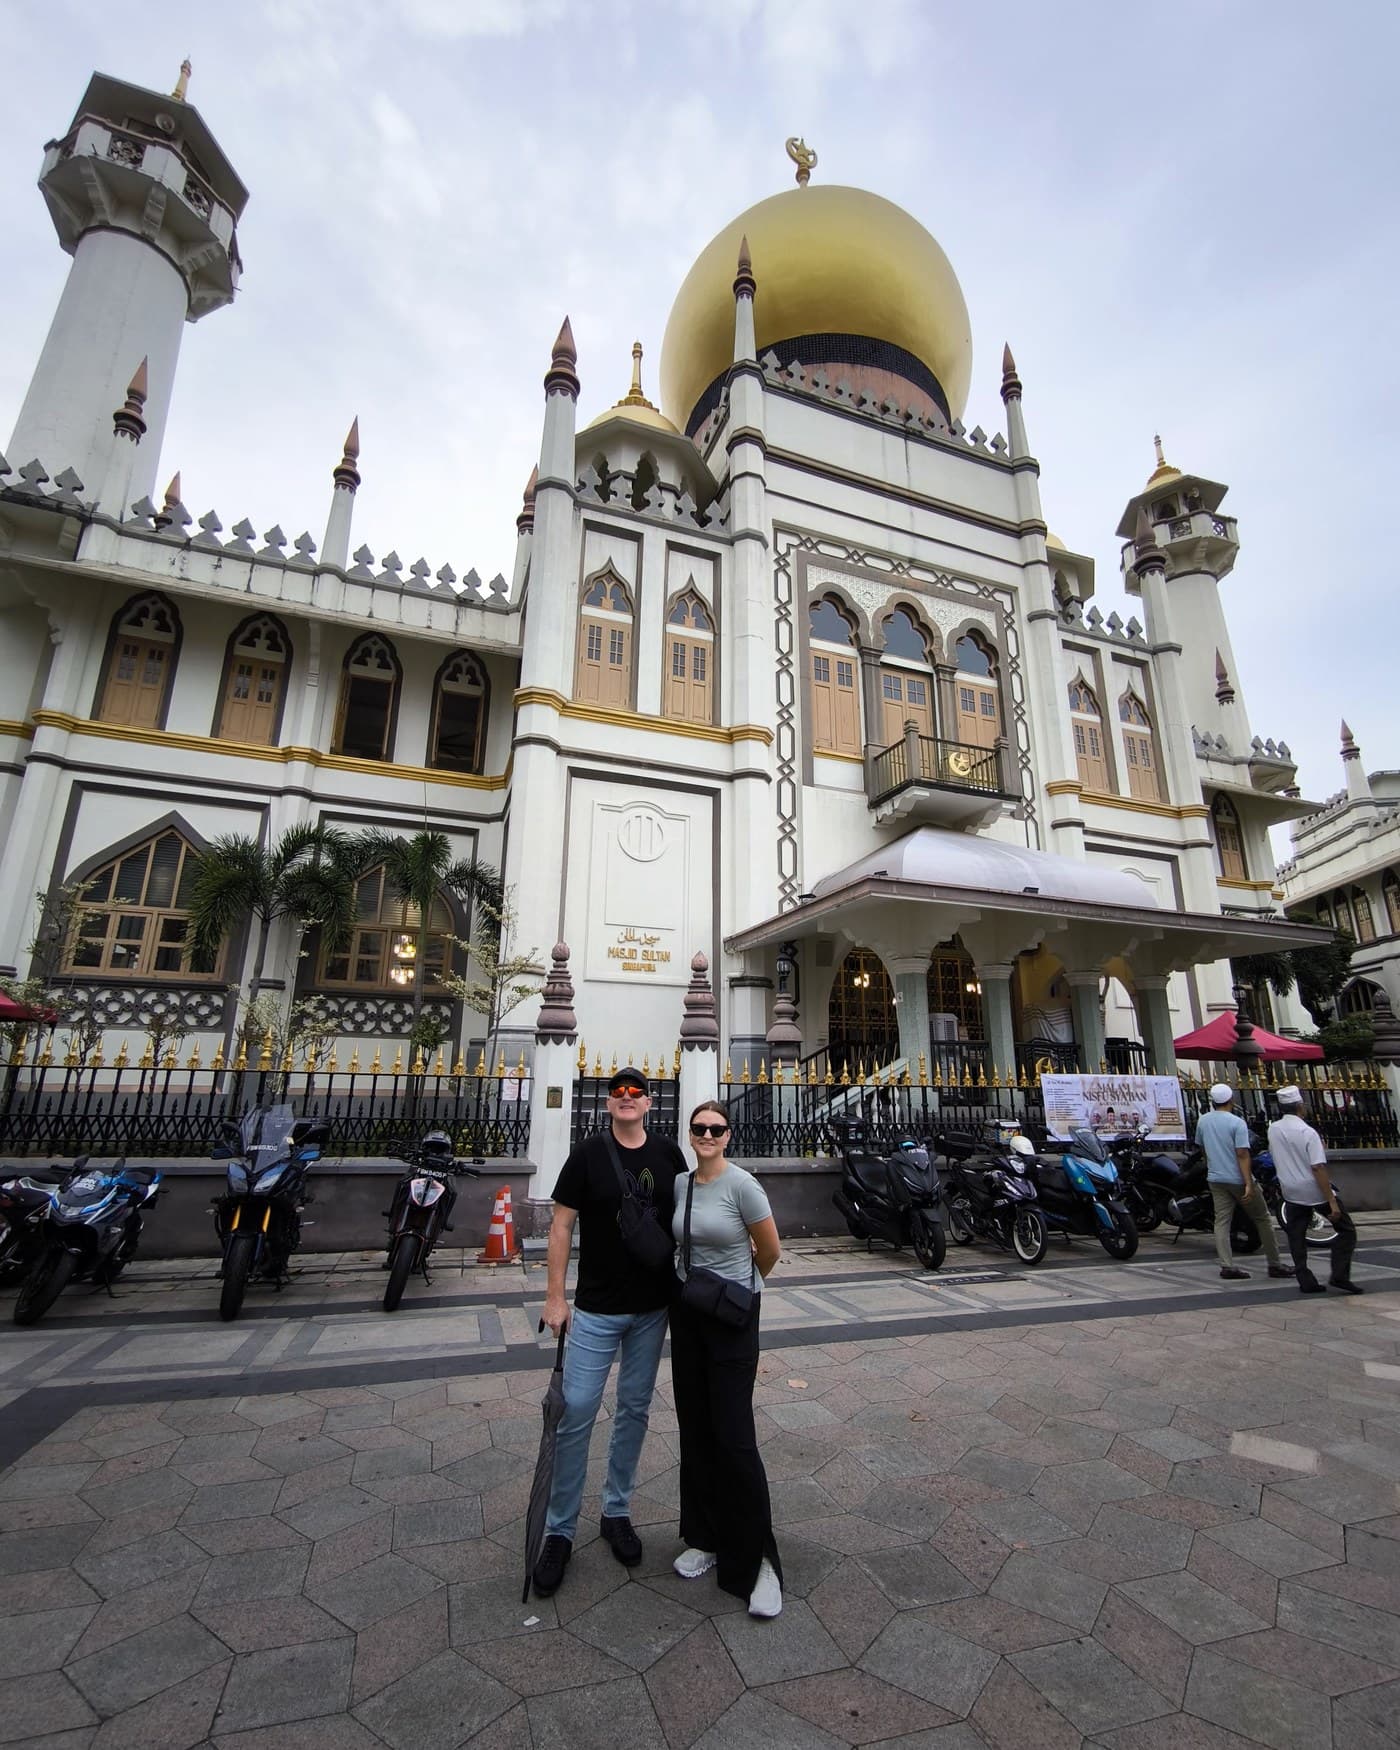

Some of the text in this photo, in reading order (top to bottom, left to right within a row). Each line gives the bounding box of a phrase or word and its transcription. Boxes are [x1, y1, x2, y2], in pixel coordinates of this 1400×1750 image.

[608, 947, 670, 962] MASJID SULTAN
[1082, 1091, 1109, 1102] NISFU
